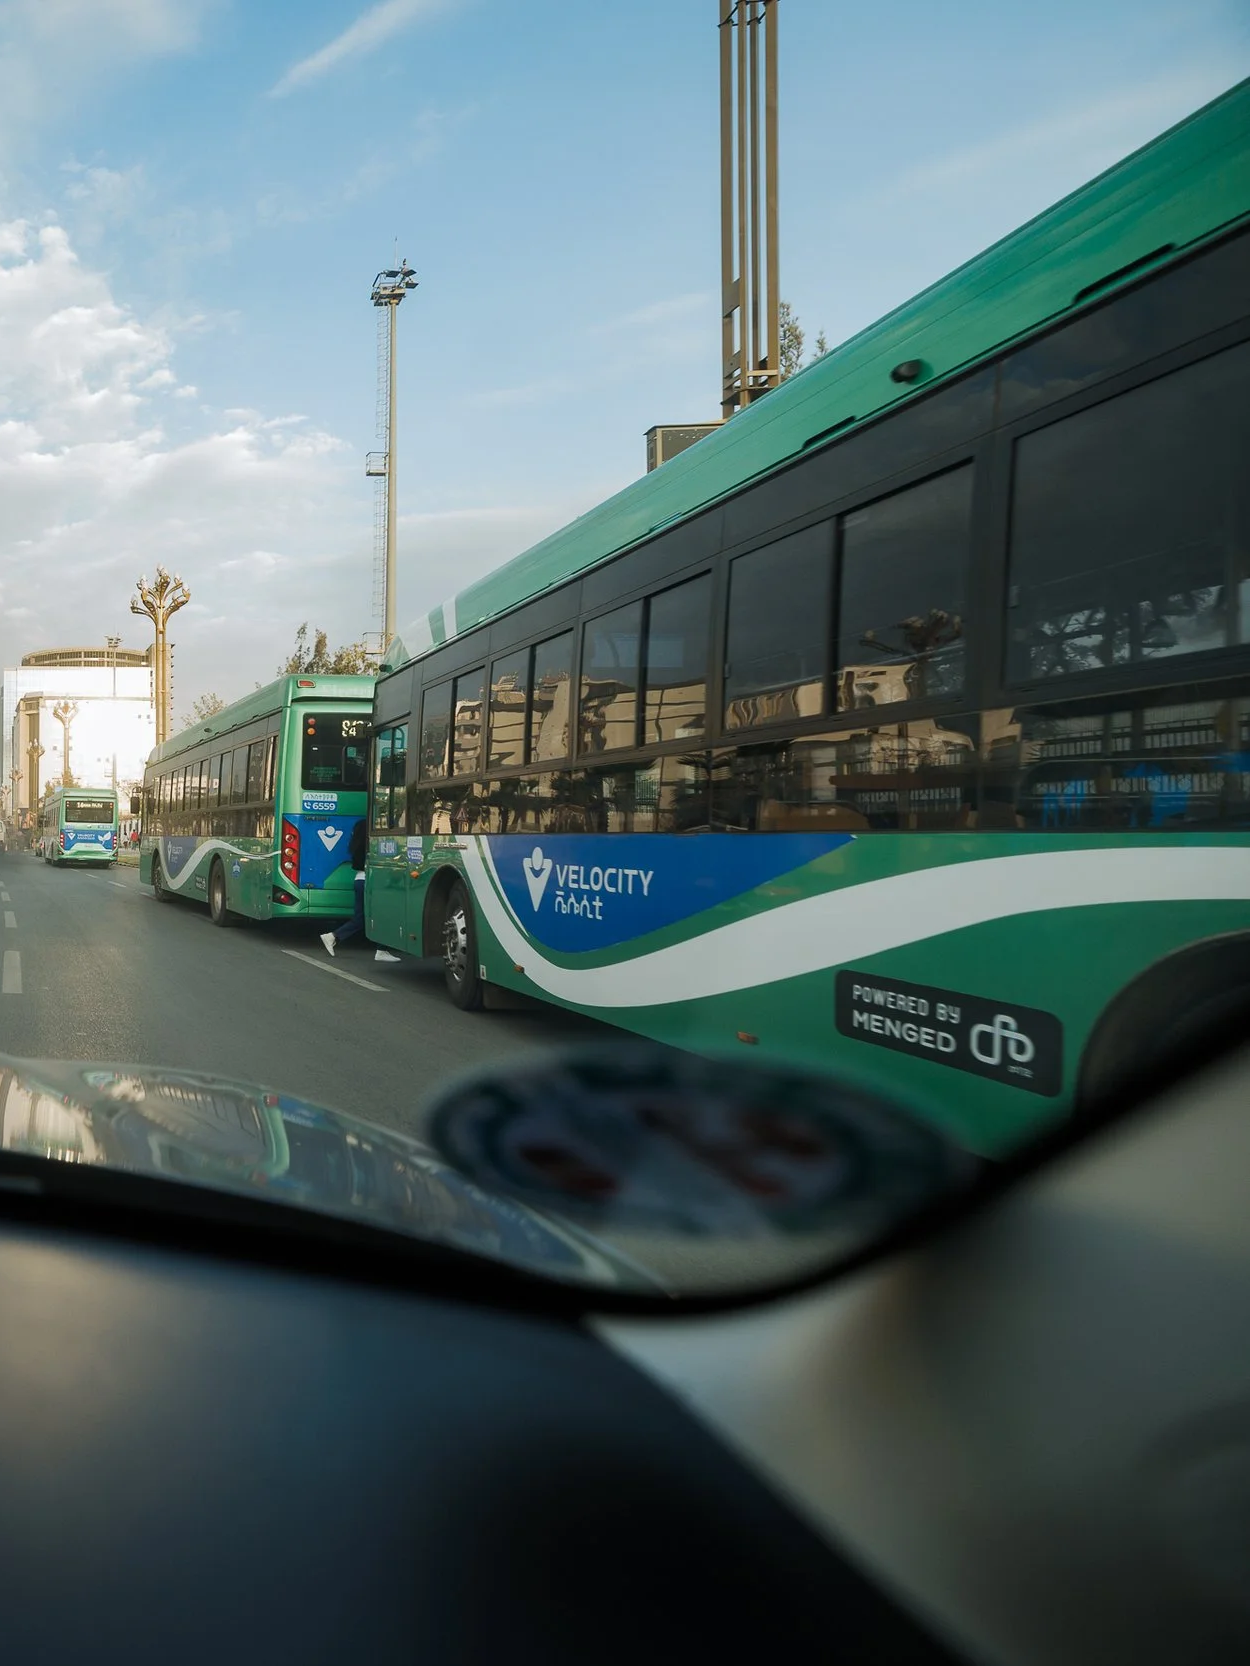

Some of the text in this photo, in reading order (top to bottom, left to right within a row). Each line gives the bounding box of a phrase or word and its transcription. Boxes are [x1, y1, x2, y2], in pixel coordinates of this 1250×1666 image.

[312, 802, 336, 810] 6559
[556, 864, 654, 896] VELOCITY
[853, 984, 961, 1024] POWERED BY
[852, 1009, 957, 1053] MENGED
